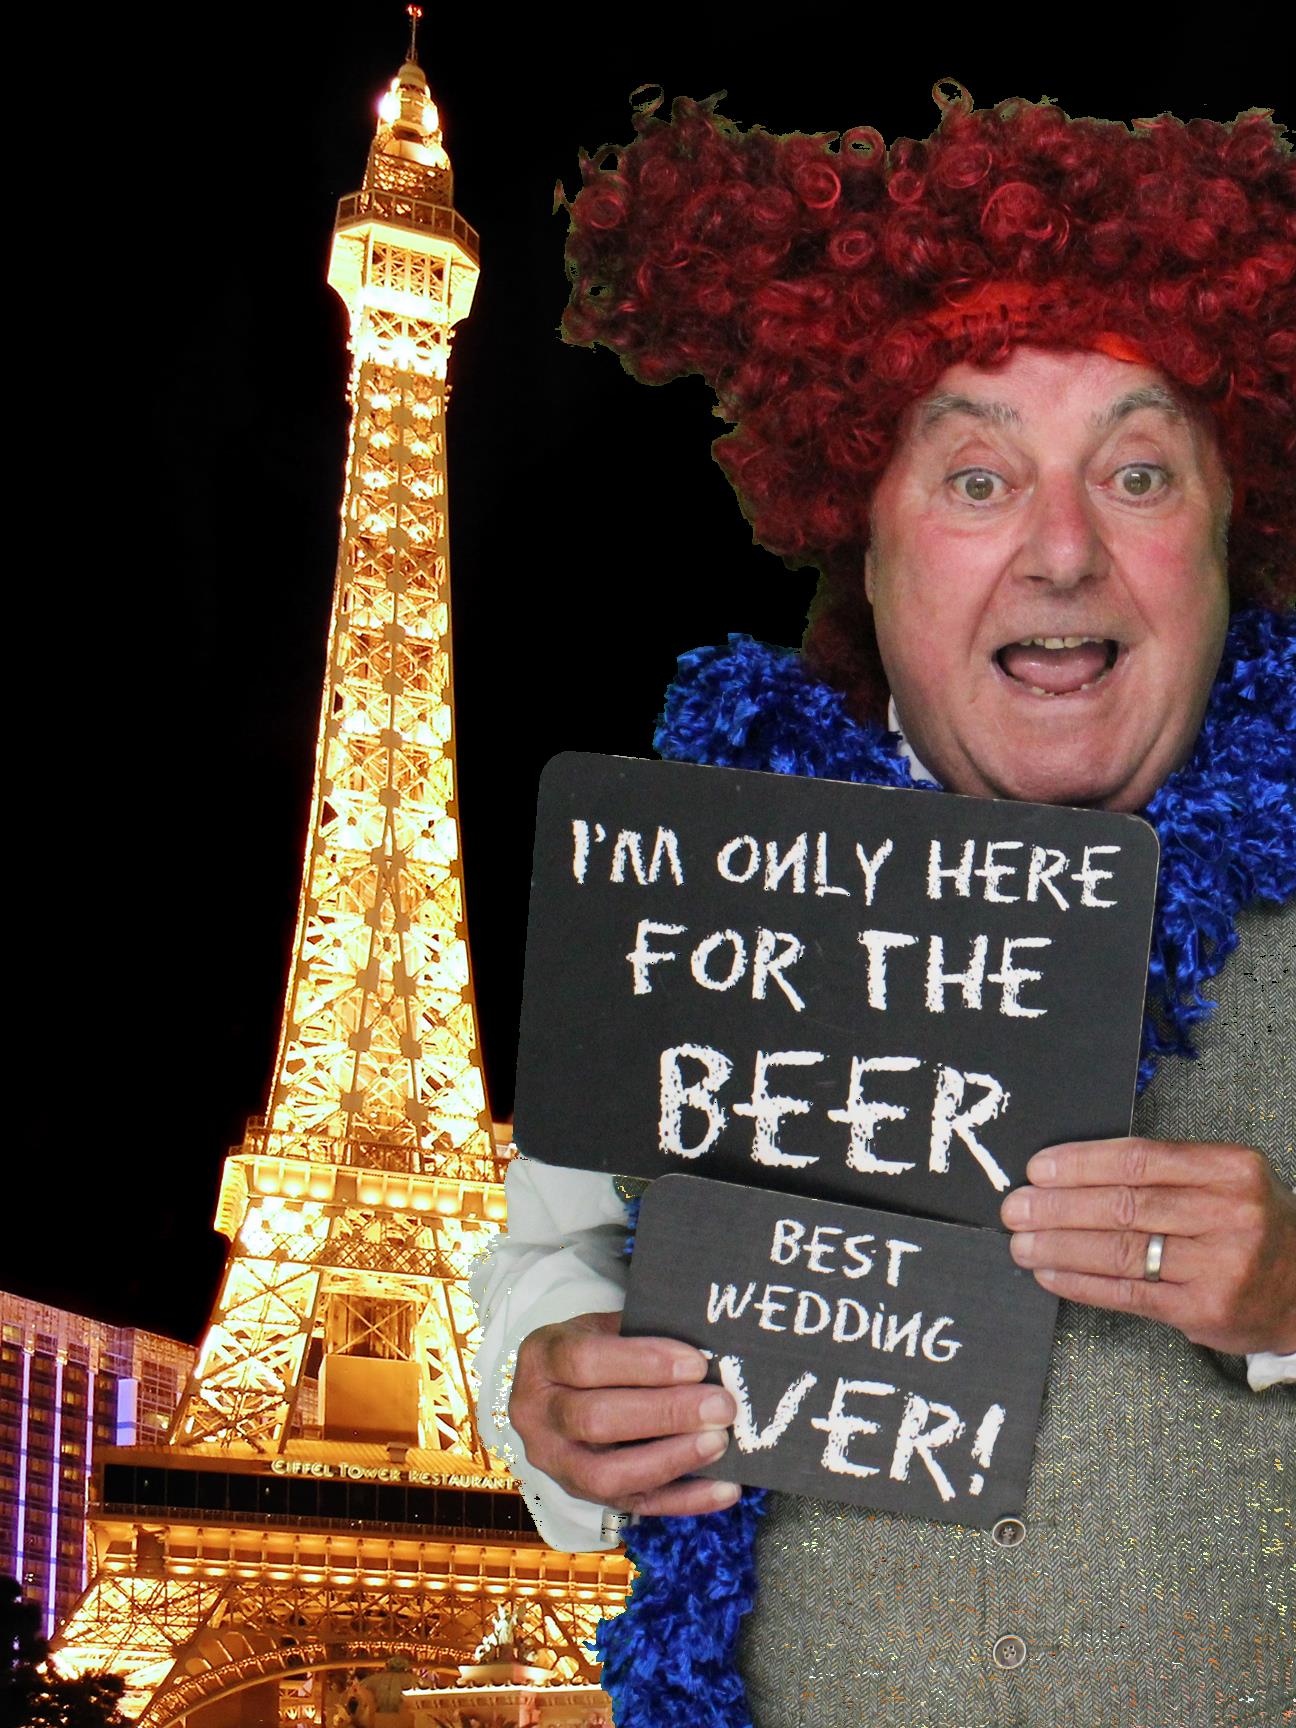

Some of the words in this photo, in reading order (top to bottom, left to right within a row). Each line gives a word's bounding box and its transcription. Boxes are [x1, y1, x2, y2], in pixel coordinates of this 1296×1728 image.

[572, 819, 684, 886] I'M
[717, 831, 893, 906] ONLY
[926, 839, 1122, 912] HERE
[625, 918, 806, 1012] FOR
[857, 929, 1053, 1019] THE
[657, 1042, 1012, 1192] BEER
[769, 1218, 922, 1288] BEST
[271, 1459, 334, 1478] EIFFEL
[338, 1461, 401, 1481] TOWER
[408, 1469, 515, 1490] RESTAURANT
[700, 1350, 1007, 1502] VER!
